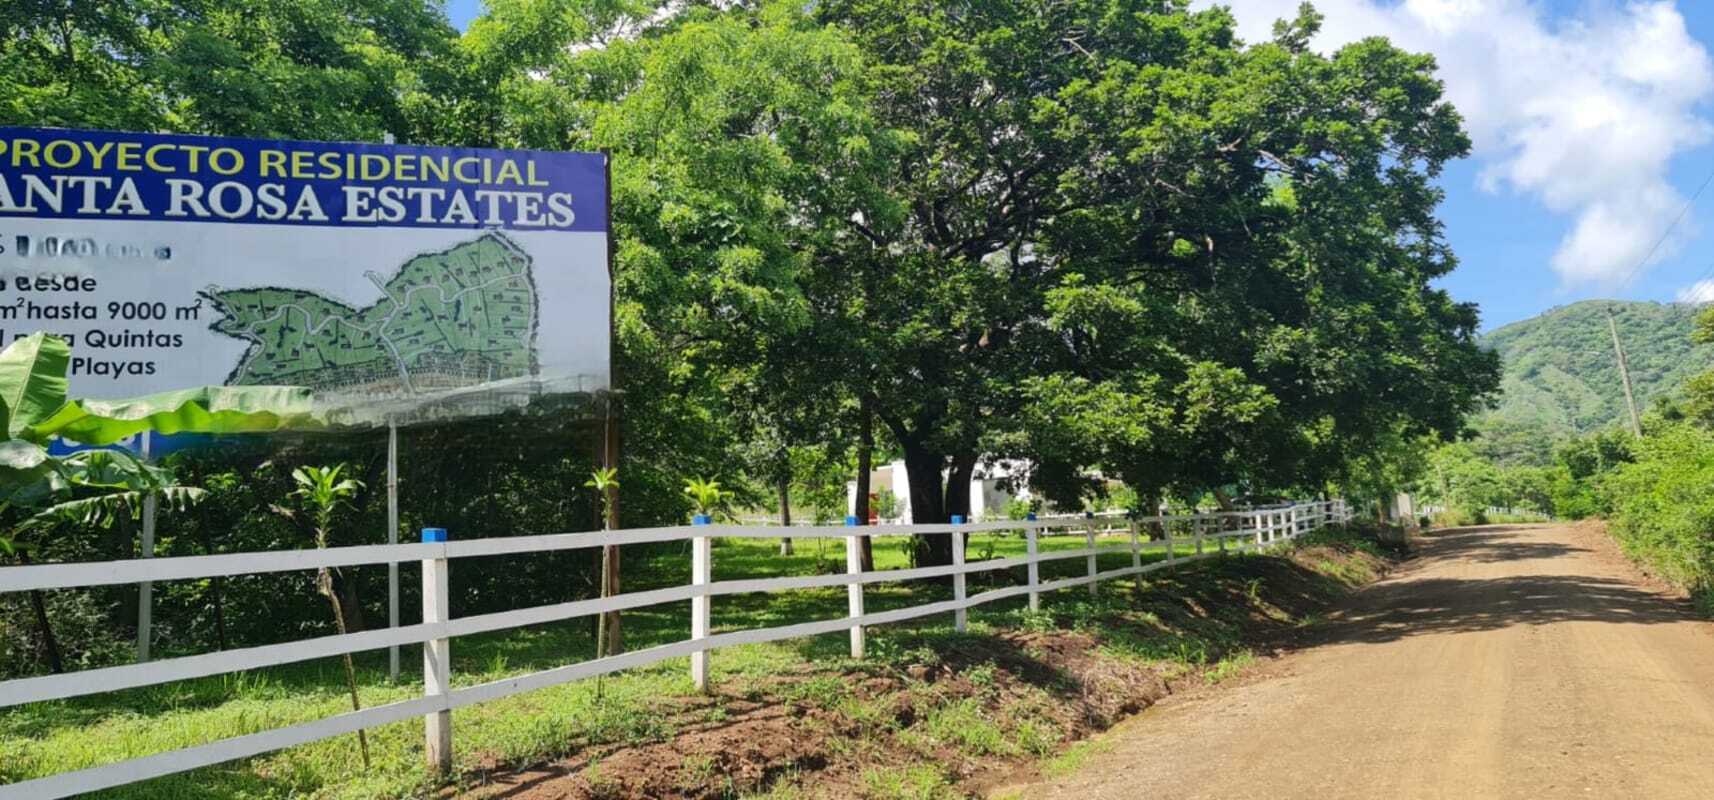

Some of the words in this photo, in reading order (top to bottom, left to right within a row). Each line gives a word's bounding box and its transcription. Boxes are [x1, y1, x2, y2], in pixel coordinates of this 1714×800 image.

[260, 150, 549, 186] RESIDENCIAL
[166, 179, 329, 221] ROSA
[342, 186, 575, 228] ESTATES
[27, 301, 98, 320] hasta
[107, 302, 166, 321] 9000
[85, 329, 184, 350] Quintas
[72, 357, 156, 380] Playas
